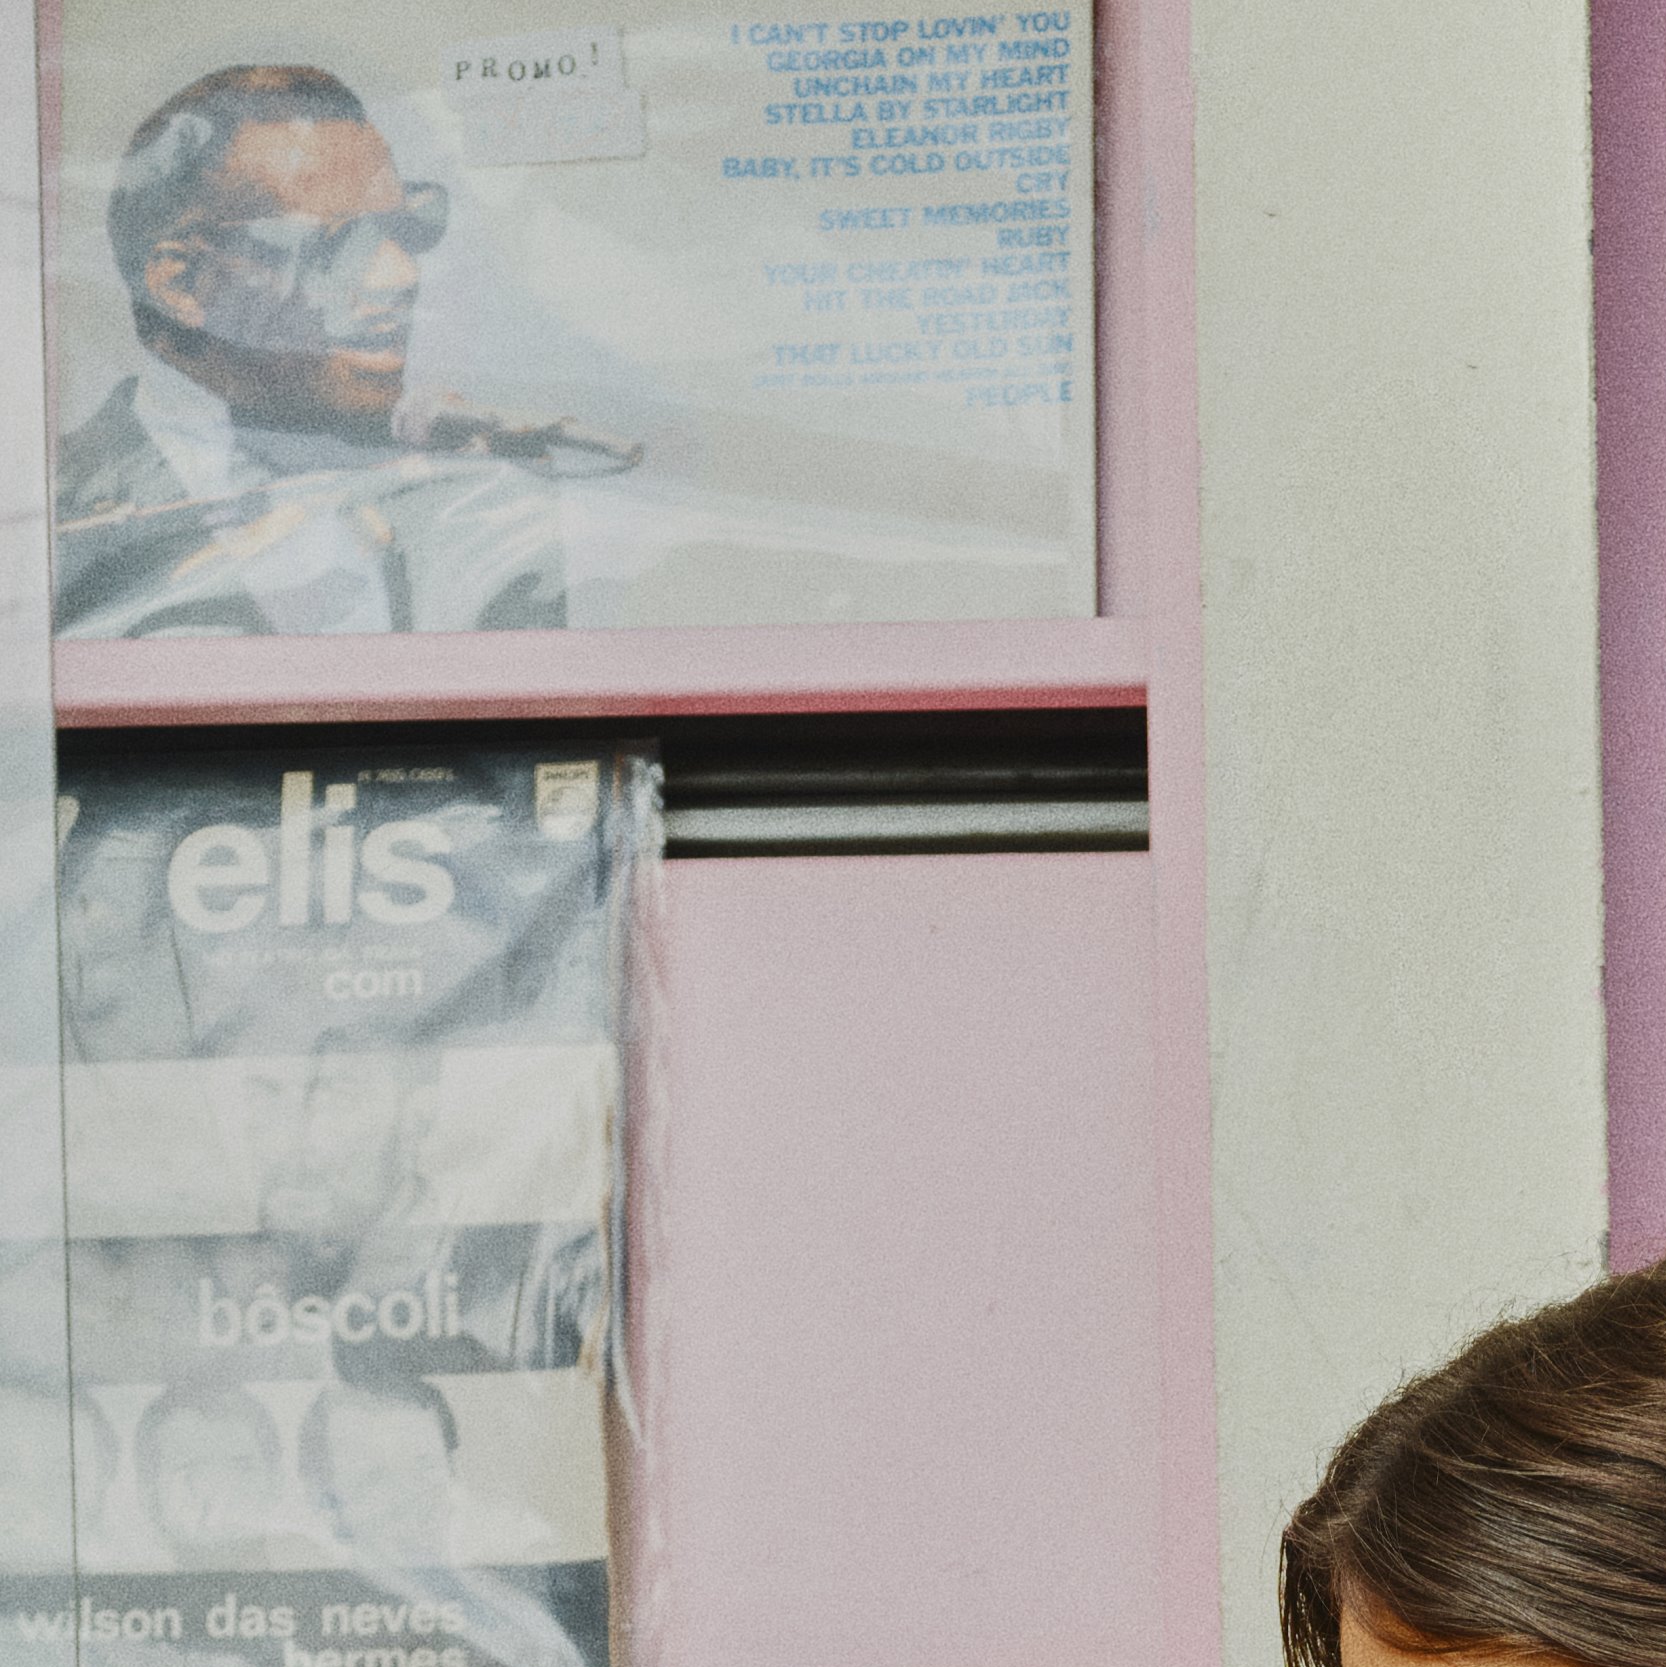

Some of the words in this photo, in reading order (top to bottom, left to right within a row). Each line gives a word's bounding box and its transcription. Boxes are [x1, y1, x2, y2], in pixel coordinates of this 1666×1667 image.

[731, 24, 740, 44] I
[750, 23, 828, 45] CAN'T
[838, 20, 909, 43] STOP
[918, 13, 1005, 40] LOVIN'
[1017, 11, 1071, 33] YOU
[767, 50, 887, 73] GEORGIA
[896, 46, 936, 68] ON
[949, 43, 987, 66] MY
[998, 38, 1071, 61] MIND
[794, 74, 917, 98] UNCHAIN
[928, 70, 971, 92] MY
[980, 63, 1070, 88] HEART
[764, 101, 868, 126] STELLA
[877, 99, 912, 122] BY
[923, 90, 1071, 120] STARLIGHT
[852, 124, 978, 150] ELEANOR
[989, 116, 1071, 141] RIGBY
[722, 156, 799, 180] BABY,
[810, 155, 861, 178] IT'S
[870, 151, 945, 176] COLD
[955, 145, 1071, 171] OUTSIDE
[1016, 170, 1071, 194] CRY
[819, 208, 912, 232] SWEET
[922, 200, 1071, 226] MEMORIES
[997, 226, 1071, 249] RUBY
[981, 251, 1071, 277] HEART
[168, 771, 456, 933] elis
[324, 966, 423, 1001] com
[15, 1596, 183, 1643] wilson
[206, 1594, 298, 1639] das
[321, 1600, 467, 1636] neves
